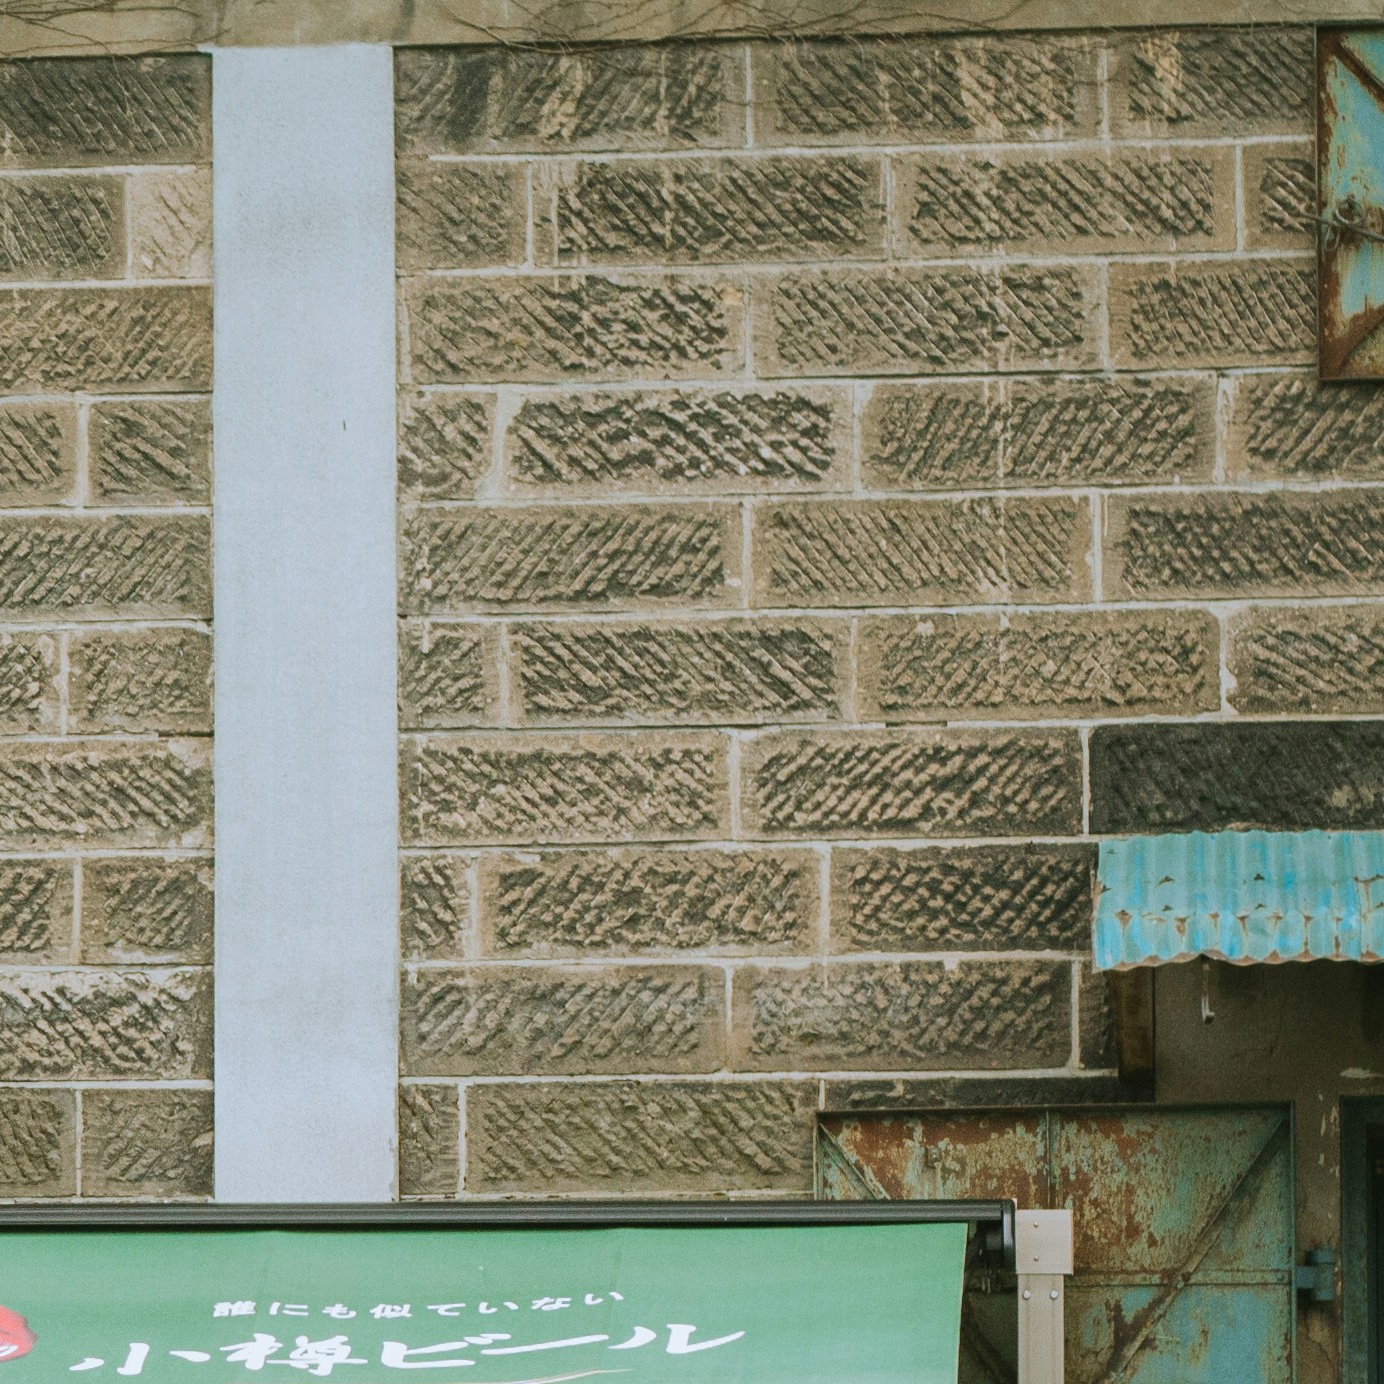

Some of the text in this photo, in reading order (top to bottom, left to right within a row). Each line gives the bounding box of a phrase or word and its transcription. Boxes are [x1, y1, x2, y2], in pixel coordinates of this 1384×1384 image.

[212, 1291, 624, 1318] 誰にも似ていない
[69, 1323, 747, 1376] 小樽ビール
